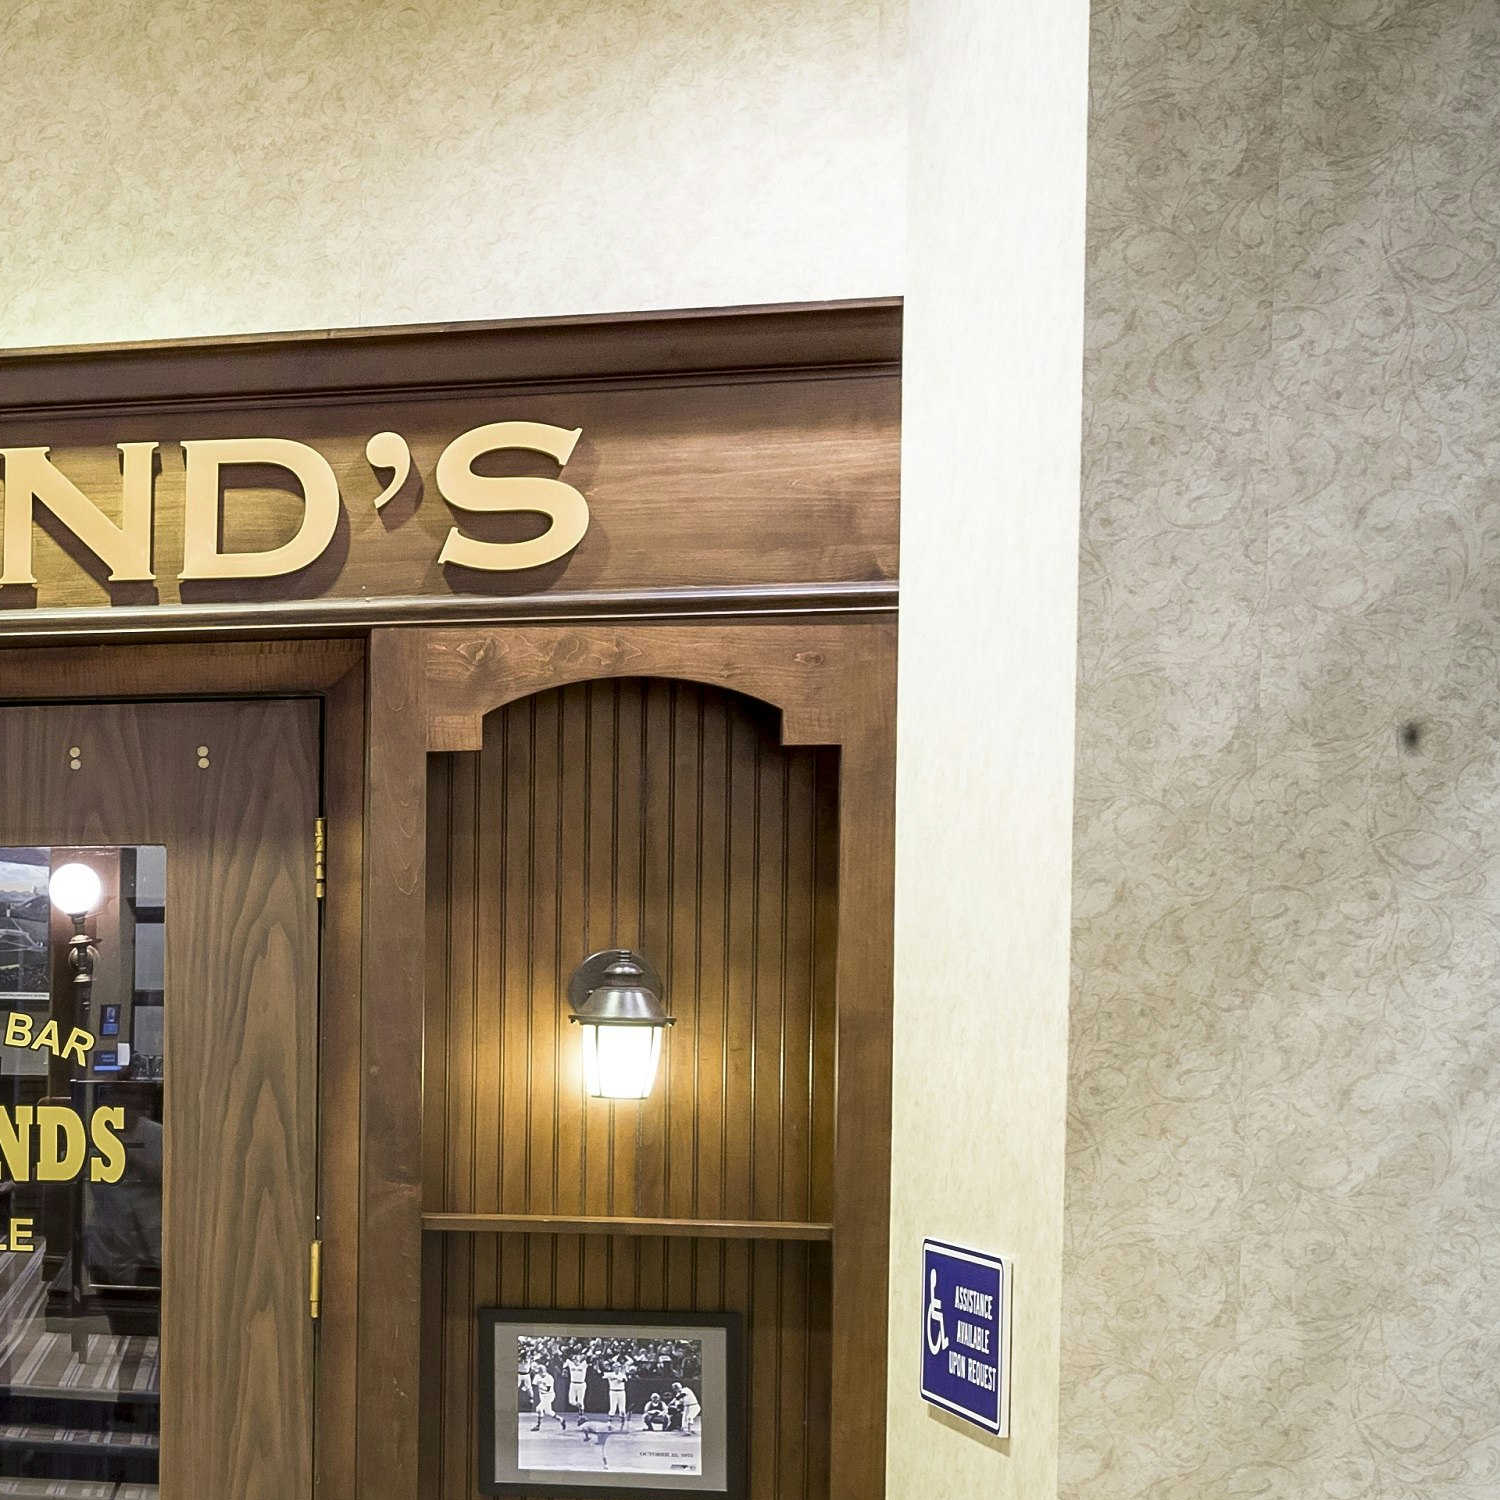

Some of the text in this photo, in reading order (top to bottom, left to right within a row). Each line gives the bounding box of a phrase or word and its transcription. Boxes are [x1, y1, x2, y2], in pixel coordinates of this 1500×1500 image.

[4, 1012, 96, 1066] BAR
[954, 1286, 993, 1320] ASSISTANCE
[957, 1320, 990, 1354] AVAILABLE
[949, 1350, 996, 1392] UPON REQUEST
